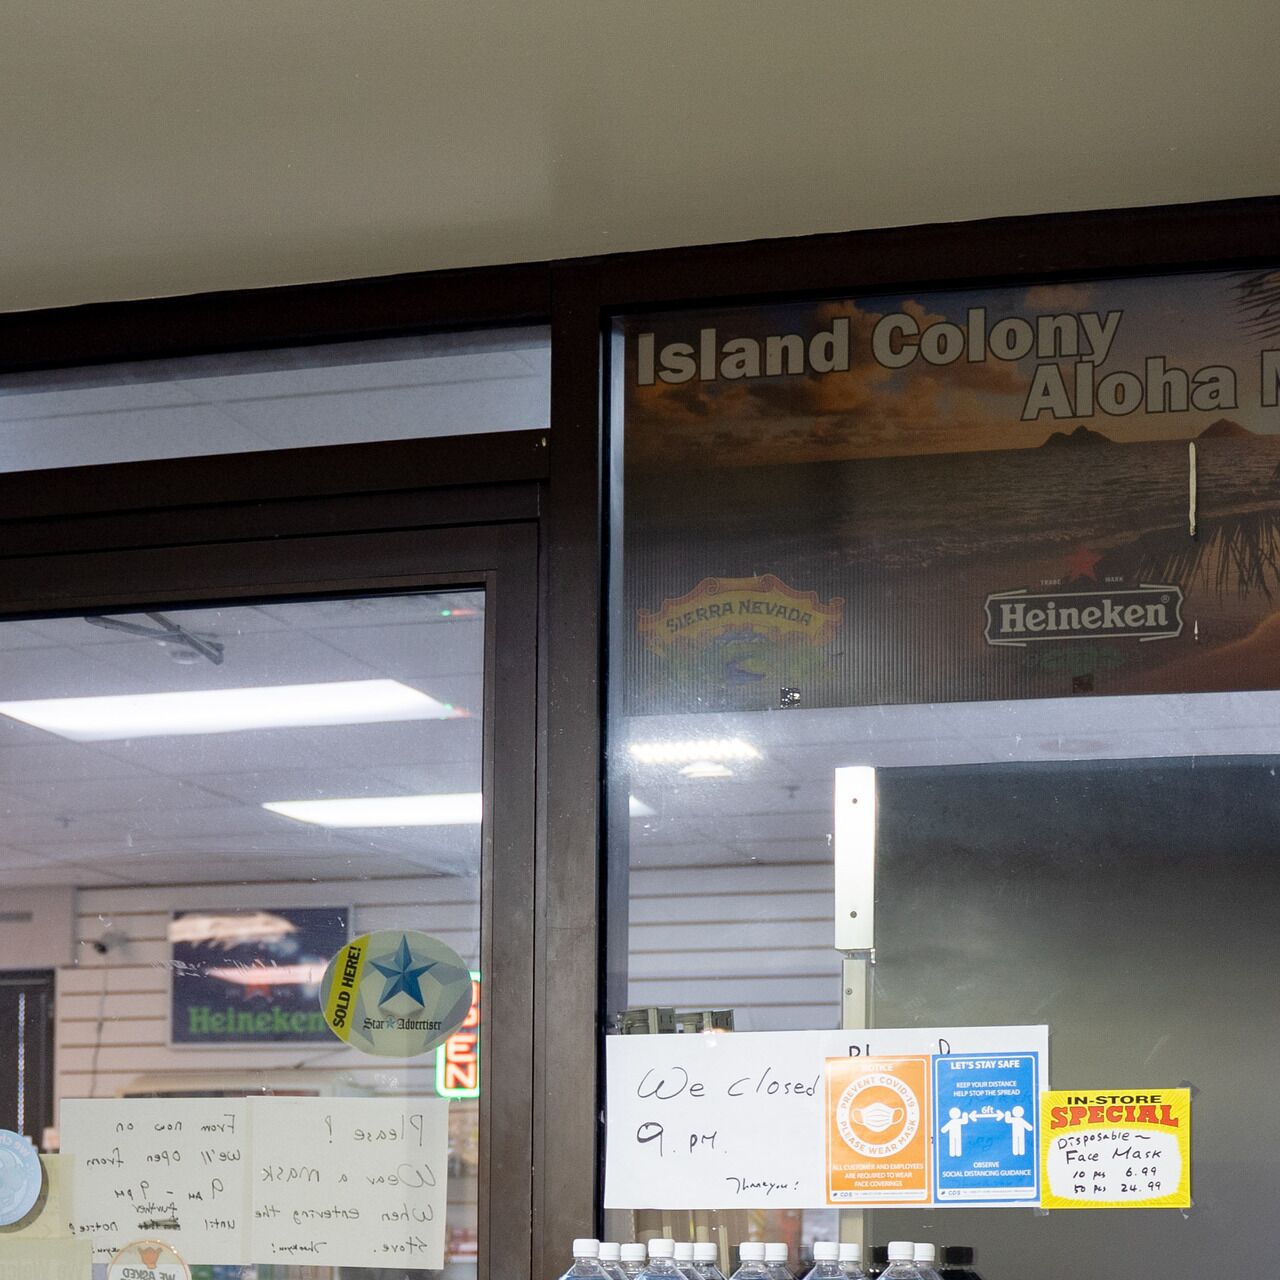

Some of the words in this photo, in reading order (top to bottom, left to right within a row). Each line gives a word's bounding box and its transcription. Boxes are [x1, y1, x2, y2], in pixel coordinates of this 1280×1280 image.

[637, 317, 850, 386] Island
[871, 307, 1122, 368] Colony
[1020, 356, 1238, 421] Aloha
[666, 601, 734, 633] SIERRA
[738, 599, 813, 626] NEVADA
[999, 599, 1169, 633] Heineken
[341, 946, 362, 988] HERE!
[188, 1006, 326, 1033] Heineken
[333, 991, 351, 1028] SOLD
[362, 1017, 385, 1031] Star
[396, 1017, 442, 1031] Advertiser
[950, 1061, 974, 1070] LET'S
[973, 1060, 997, 1069] STAY
[998, 1060, 1020, 1069] SAFE
[637, 1066, 705, 1100] We
[727, 1066, 820, 1097] closed
[841, 1077, 876, 1109] PREVENT
[879, 1076, 916, 1108] COVID-19
[953, 1089, 968, 1097] HELP
[968, 1089, 985, 1097] STOP
[956, 1081, 972, 1089] KEEP
[981, 1105, 994, 1114] 6ft
[1067, 1095, 1162, 1105] IN-STORE
[1050, 1105, 1179, 1130] SPECIAL
[840, 1121, 866, 1153] PLEASE
[868, 1142, 898, 1156] WEAR
[898, 1119, 917, 1146] MASK
[1057, 1130, 1130, 1150] Disposable
[973, 1161, 999, 1169] OBSERVE
[1066, 1149, 1100, 1164] Face
[1111, 1146, 1162, 1160] Mask
[942, 1170, 963, 1178] SOCIAL
[964, 1169, 1000, 1177] DISTANCING
[1000, 1169, 1032, 1177] GUIDANCE
[1073, 1171, 1086, 1179] 10
[1125, 1166, 1157, 1177] 6.99
[1074, 1184, 1086, 1193] 50
[1120, 1181, 1161, 1192] 24.99
